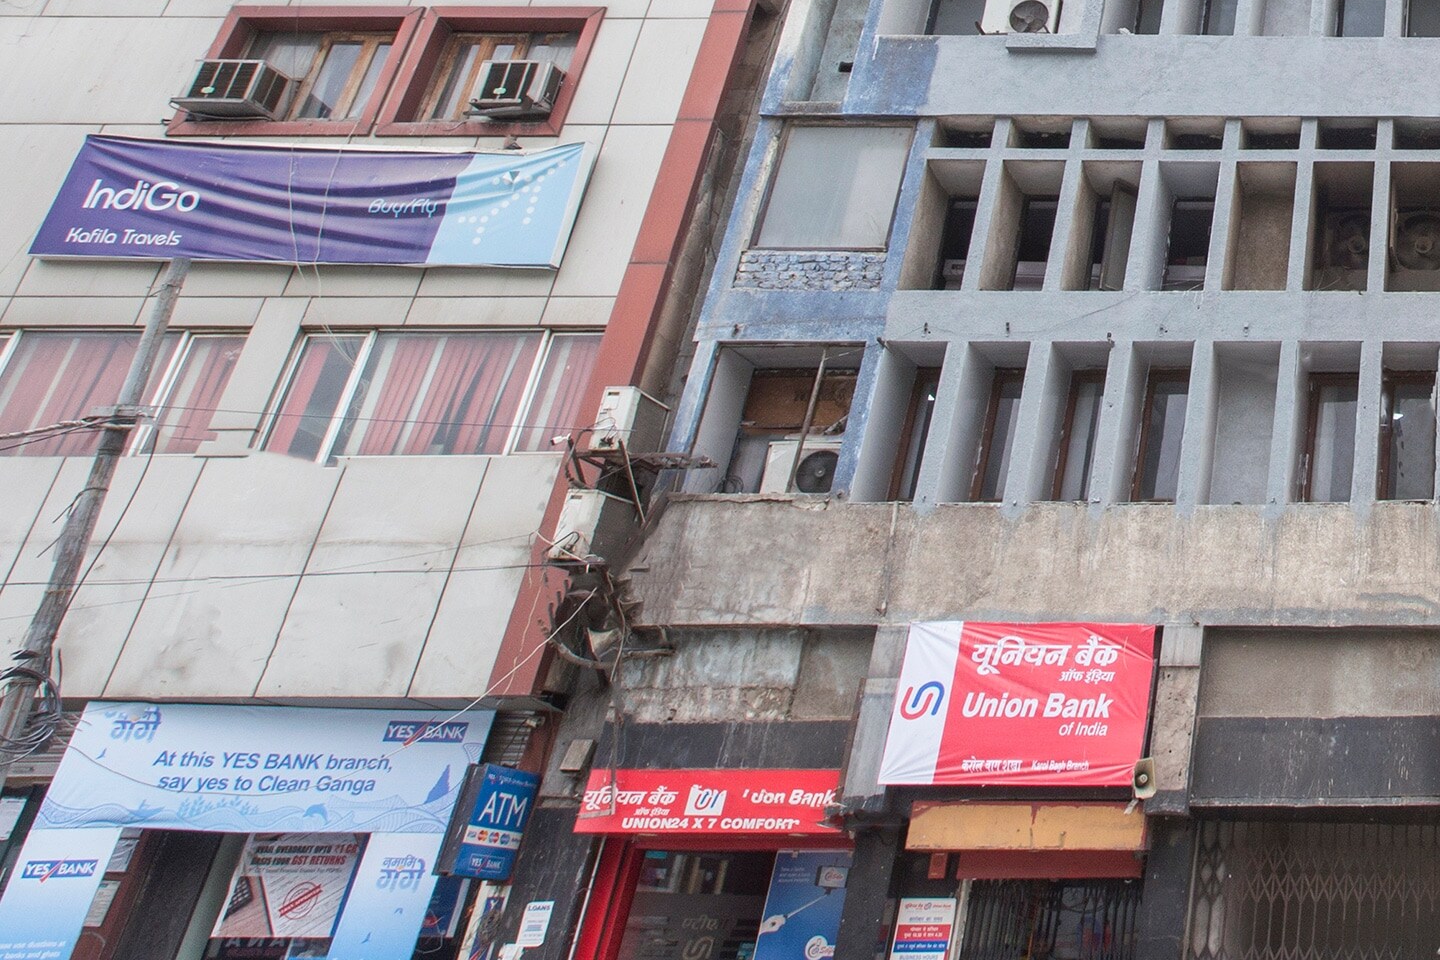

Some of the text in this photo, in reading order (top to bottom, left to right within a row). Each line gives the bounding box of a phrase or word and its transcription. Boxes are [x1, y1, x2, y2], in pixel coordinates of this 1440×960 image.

[82, 179, 200, 212] IndiGo
[65, 227, 182, 246] Kafila Travels
[971, 634, 1123, 676] यूनियन बैंक
[1059, 668, 1084, 683] ऑफ
[961, 692, 1114, 719] Union Bank
[387, 724, 467, 739] YES BANK
[1058, 721, 1108, 737] of India
[152, 750, 393, 774] At this YES BANK branch,
[158, 775, 376, 796] say yes to Clean Ganga
[583, 785, 679, 811] यूनियन बैंक
[788, 789, 836, 808] Bank
[478, 791, 529, 827] ATM
[691, 818, 704, 829] X
[707, 818, 717, 829] 7
[26, 862, 97, 876] YES BANK
[291, 855, 308, 866] GST
[309, 855, 347, 866] RETURNS
[471, 858, 483, 867] YES
[528, 904, 552, 912] LOANS
